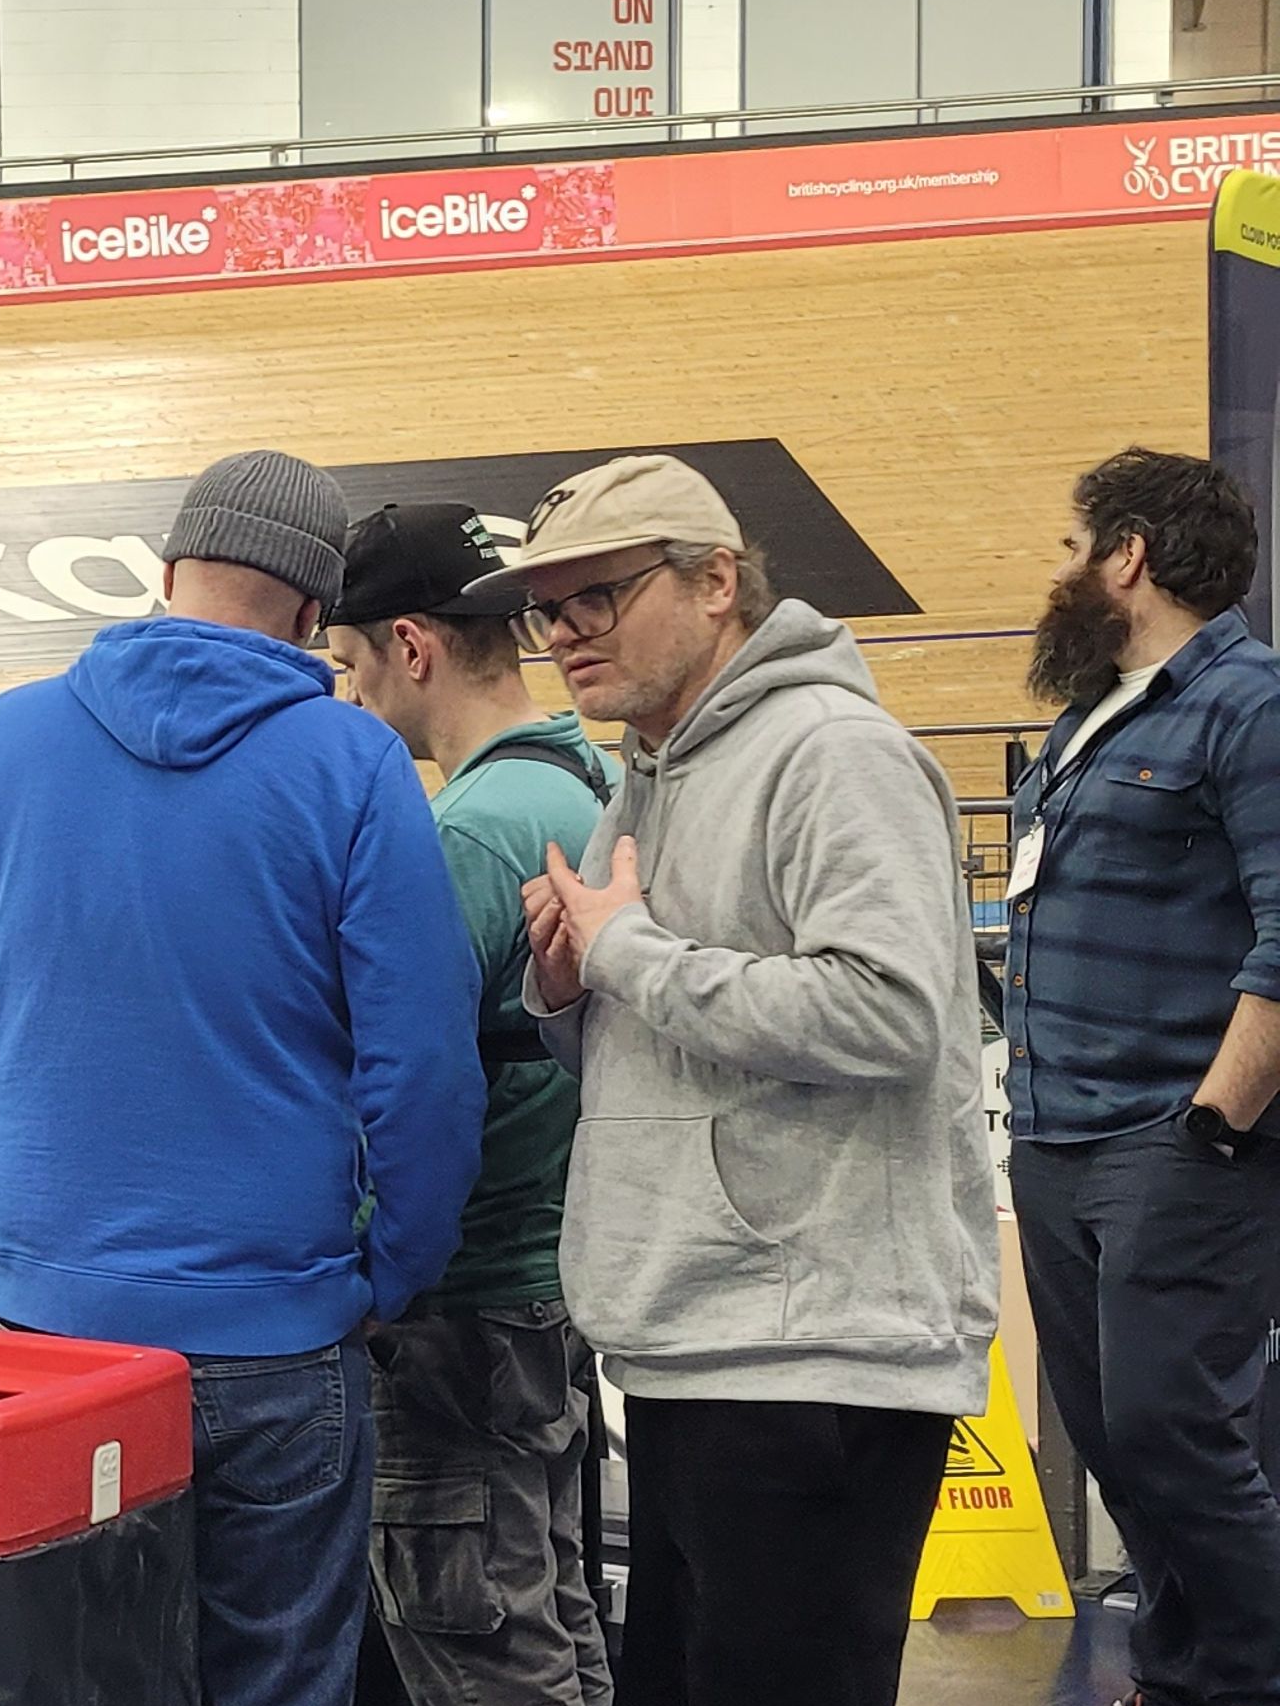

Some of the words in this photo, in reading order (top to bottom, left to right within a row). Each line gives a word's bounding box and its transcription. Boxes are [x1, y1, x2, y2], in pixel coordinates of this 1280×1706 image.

[553, 40, 653, 71] STAND
[594, 87, 653, 117] OUT
[788, 169, 999, 197] britishcycling.org.uk/membership
[948, 1485, 1013, 1511] FLOOR
